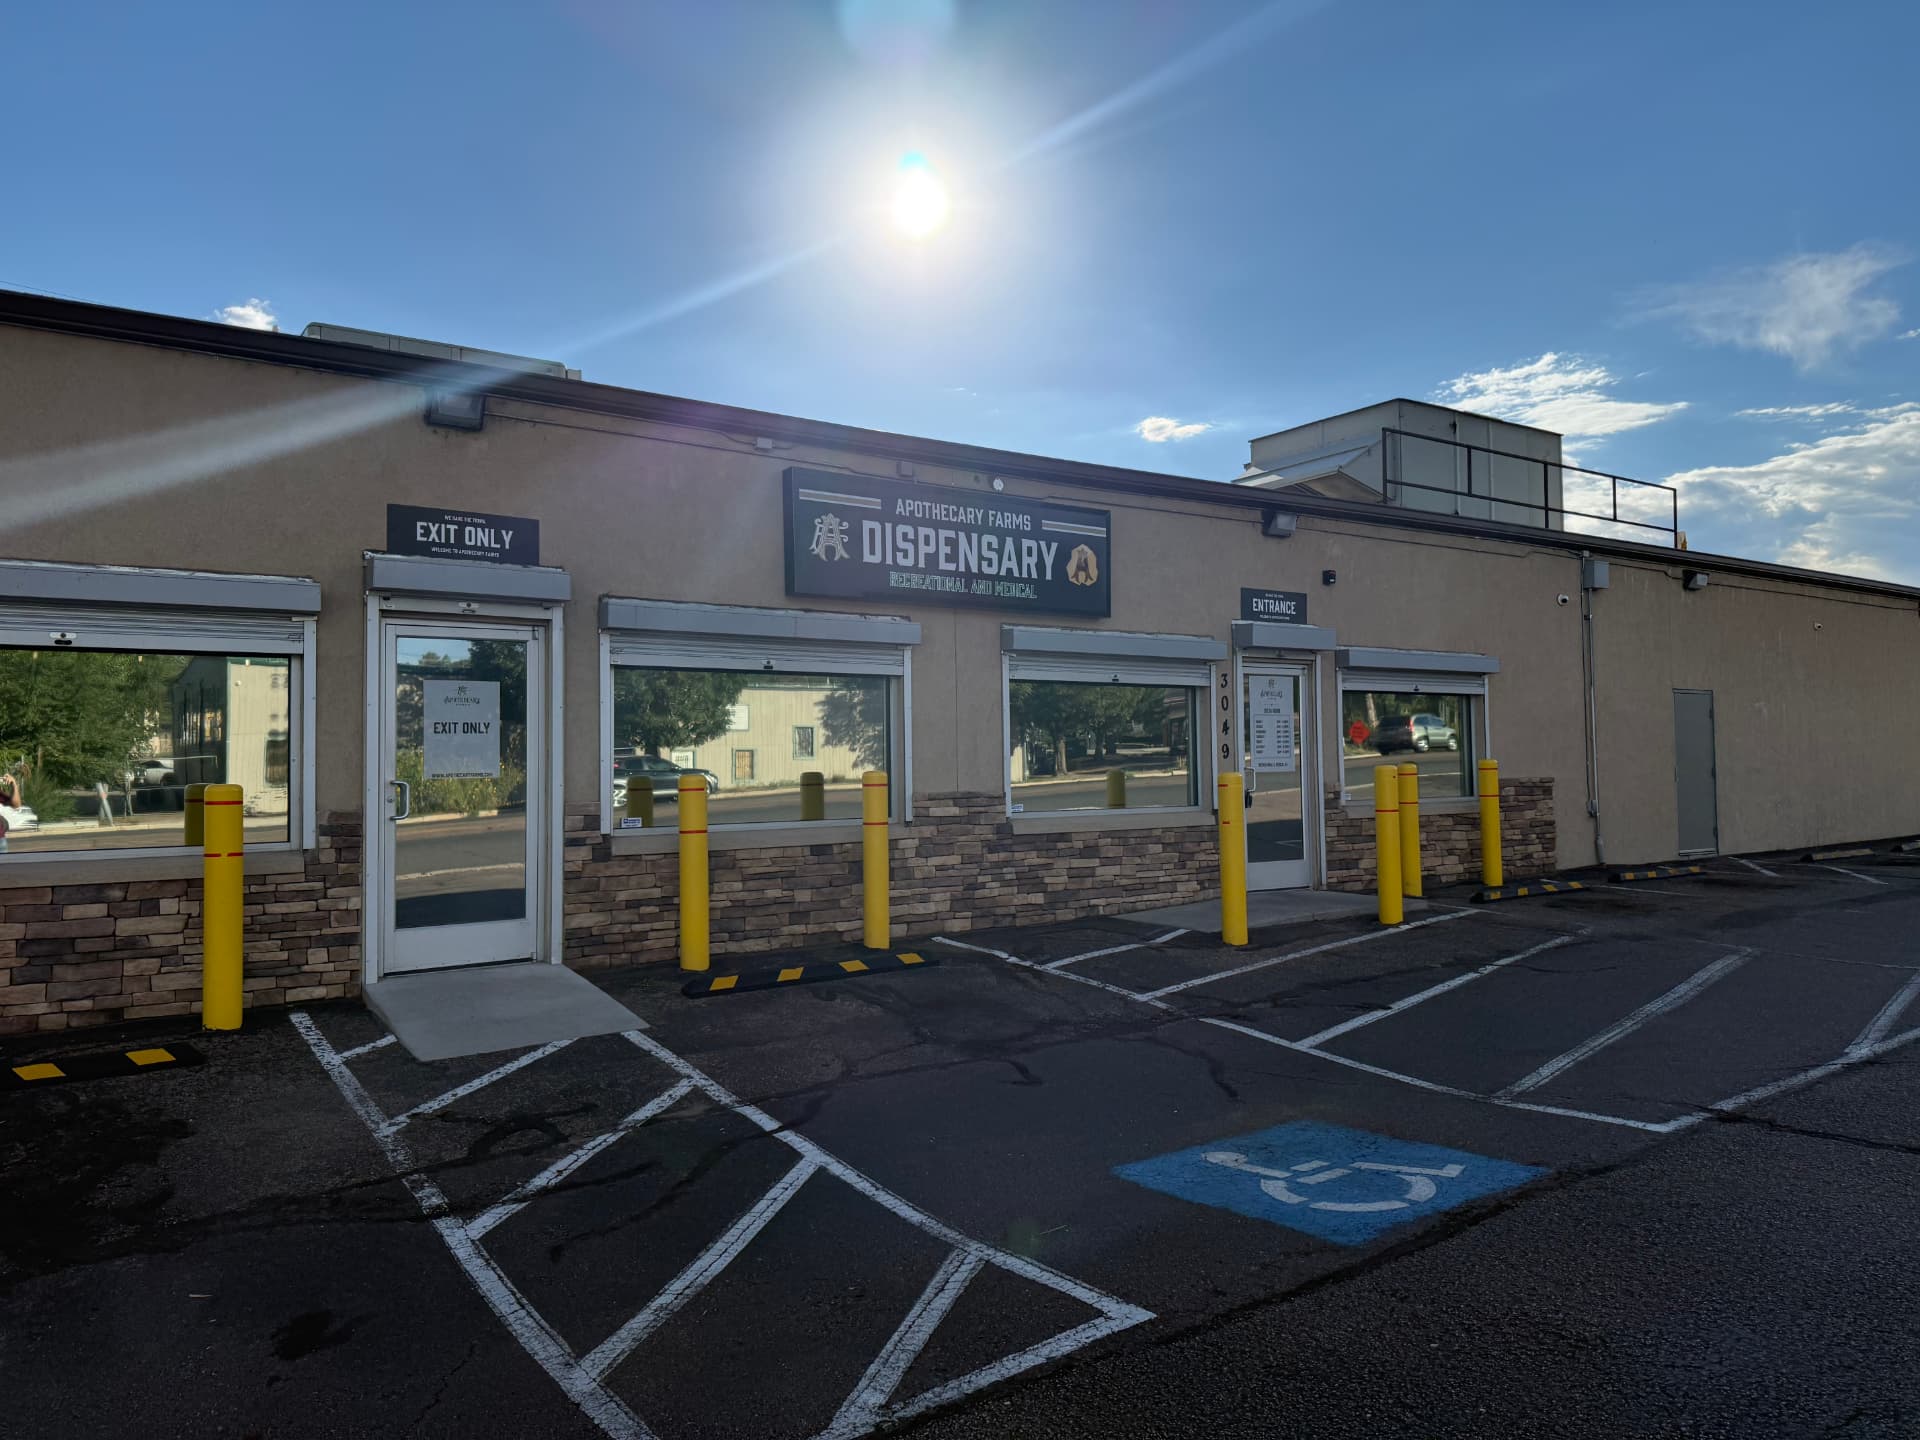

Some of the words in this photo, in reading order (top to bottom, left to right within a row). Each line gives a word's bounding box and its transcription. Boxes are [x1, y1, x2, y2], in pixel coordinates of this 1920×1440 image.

[896, 498, 983, 525] APOTHECARY
[988, 510, 1031, 531] FARMS
[416, 521, 459, 544] EXIT
[464, 526, 514, 550] ONLY
[862, 519, 1059, 581] DISPENSARY
[889, 571, 969, 593] RECREATIONAL
[970, 579, 992, 595] AND
[994, 581, 1038, 599] MEDICAL
[1252, 597, 1297, 615] ENTRANCE
[433, 721, 459, 734] EXIT
[462, 721, 491, 734] ONLY
[1220, 672, 1230, 760] 3049
